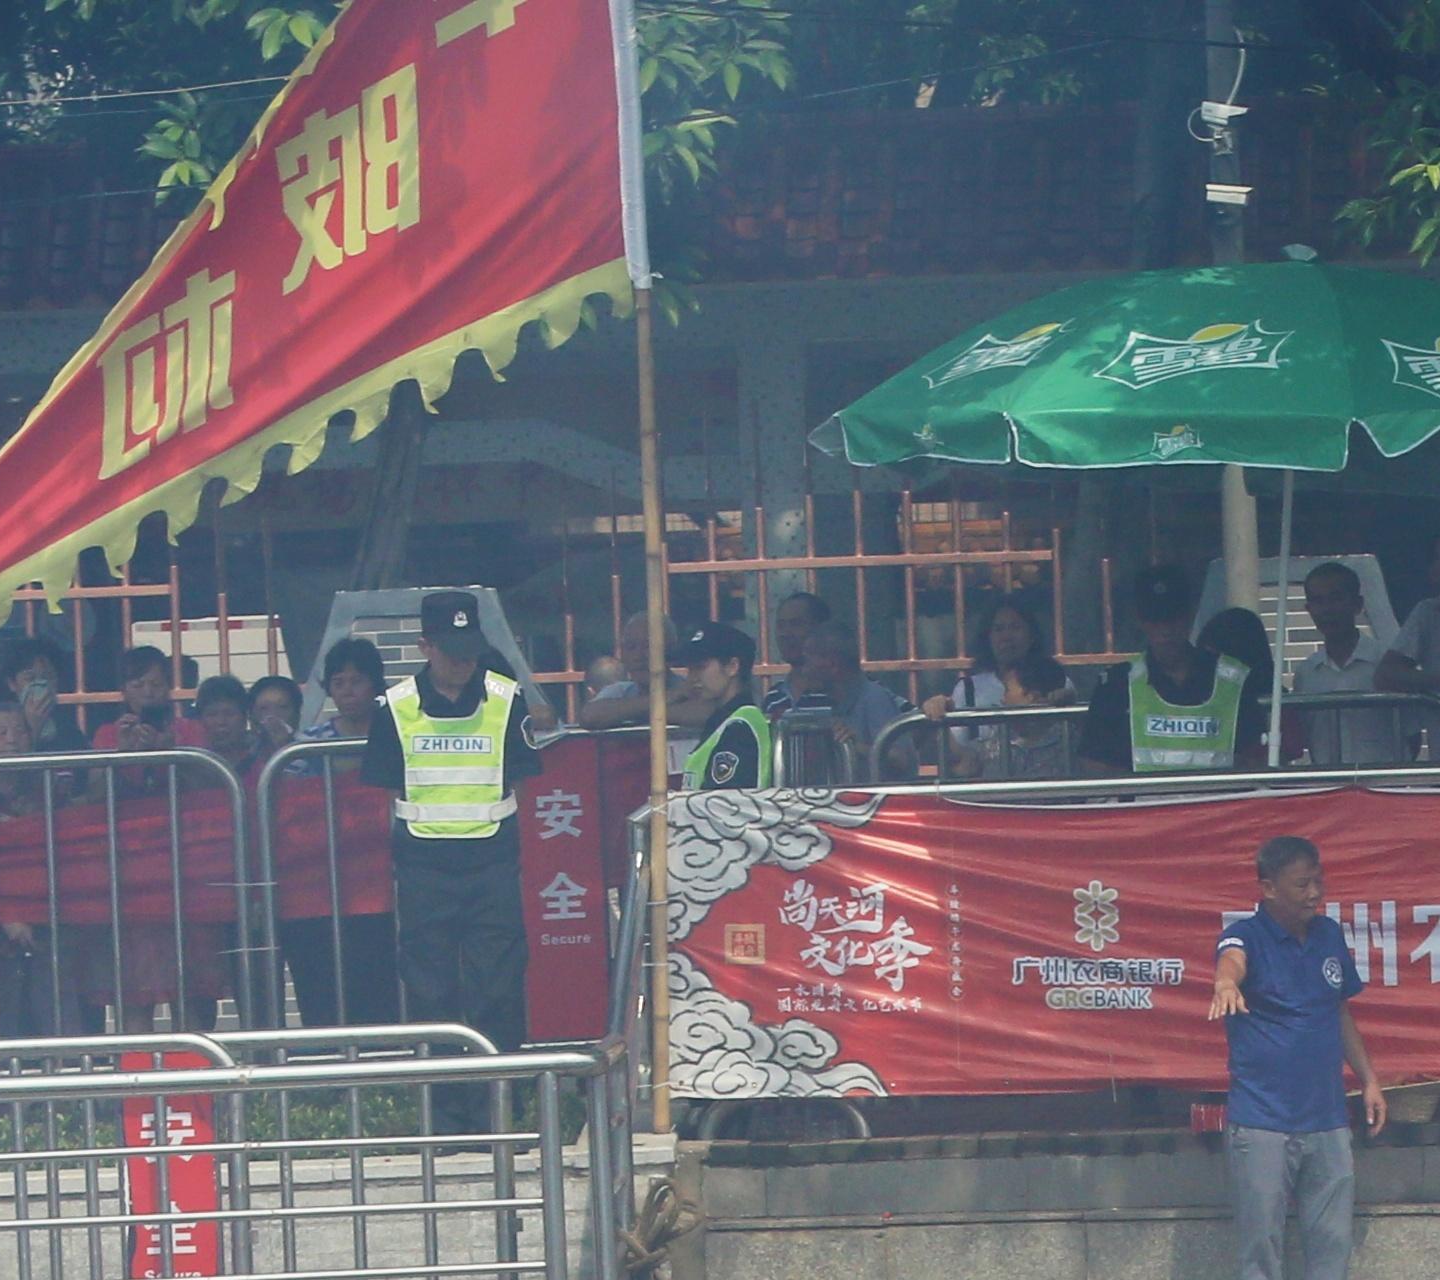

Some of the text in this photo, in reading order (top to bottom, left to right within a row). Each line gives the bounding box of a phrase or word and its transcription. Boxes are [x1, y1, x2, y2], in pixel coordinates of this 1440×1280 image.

[1132, 336, 1267, 381] 雪碧
[535, 789, 589, 922] 安全
[540, 932, 592, 946] Secure
[1012, 957, 1185, 986] 广州农商银行
[1045, 986, 1155, 1011] GRCBANK
